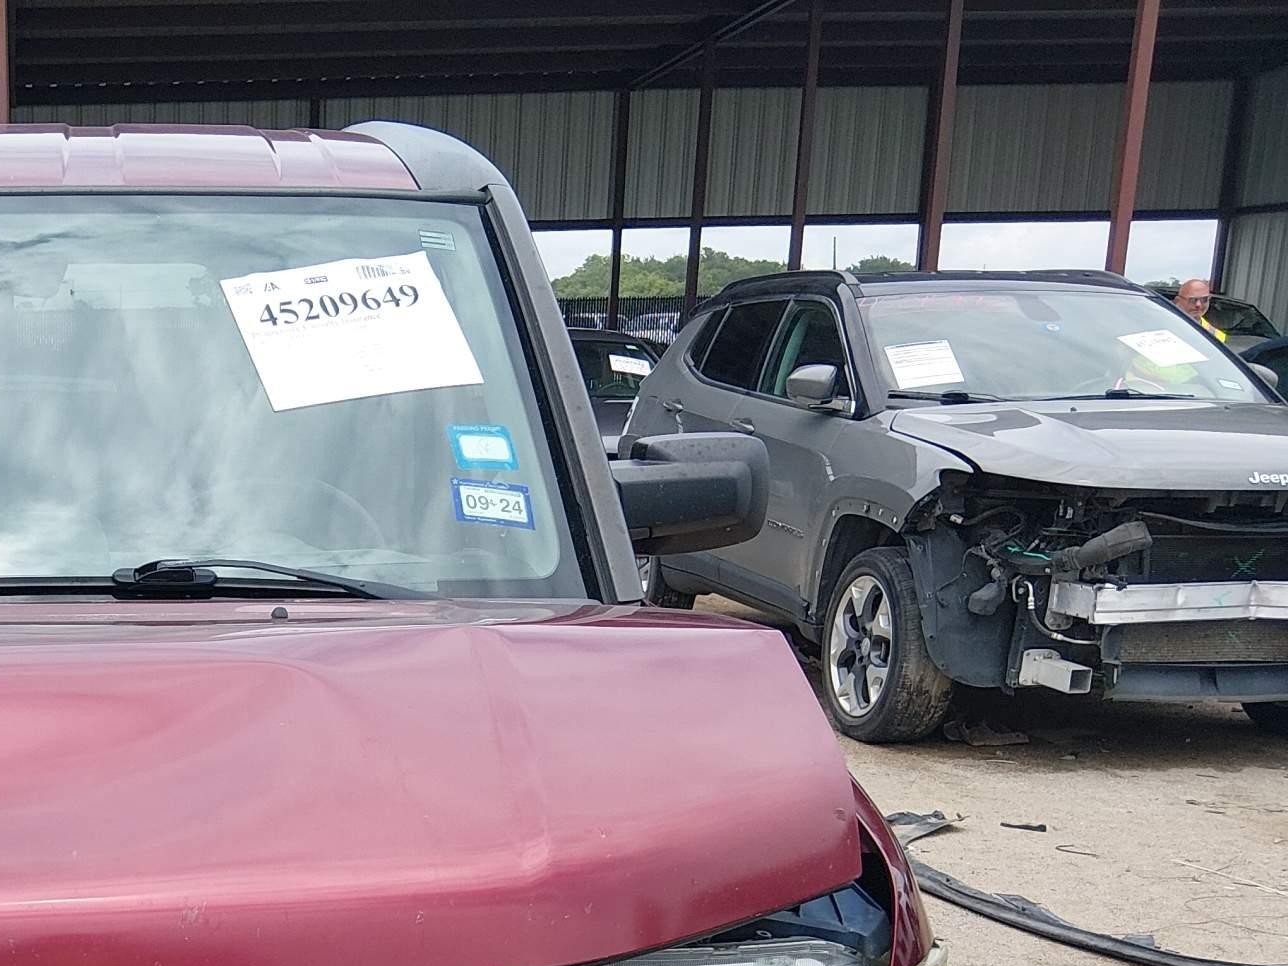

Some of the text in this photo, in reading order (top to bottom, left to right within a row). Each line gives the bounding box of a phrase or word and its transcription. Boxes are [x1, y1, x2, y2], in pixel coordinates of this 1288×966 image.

[260, 285, 419, 326] 45209649
[1248, 471, 1288, 486] Jeep
[465, 494, 523, 515] 09 24
